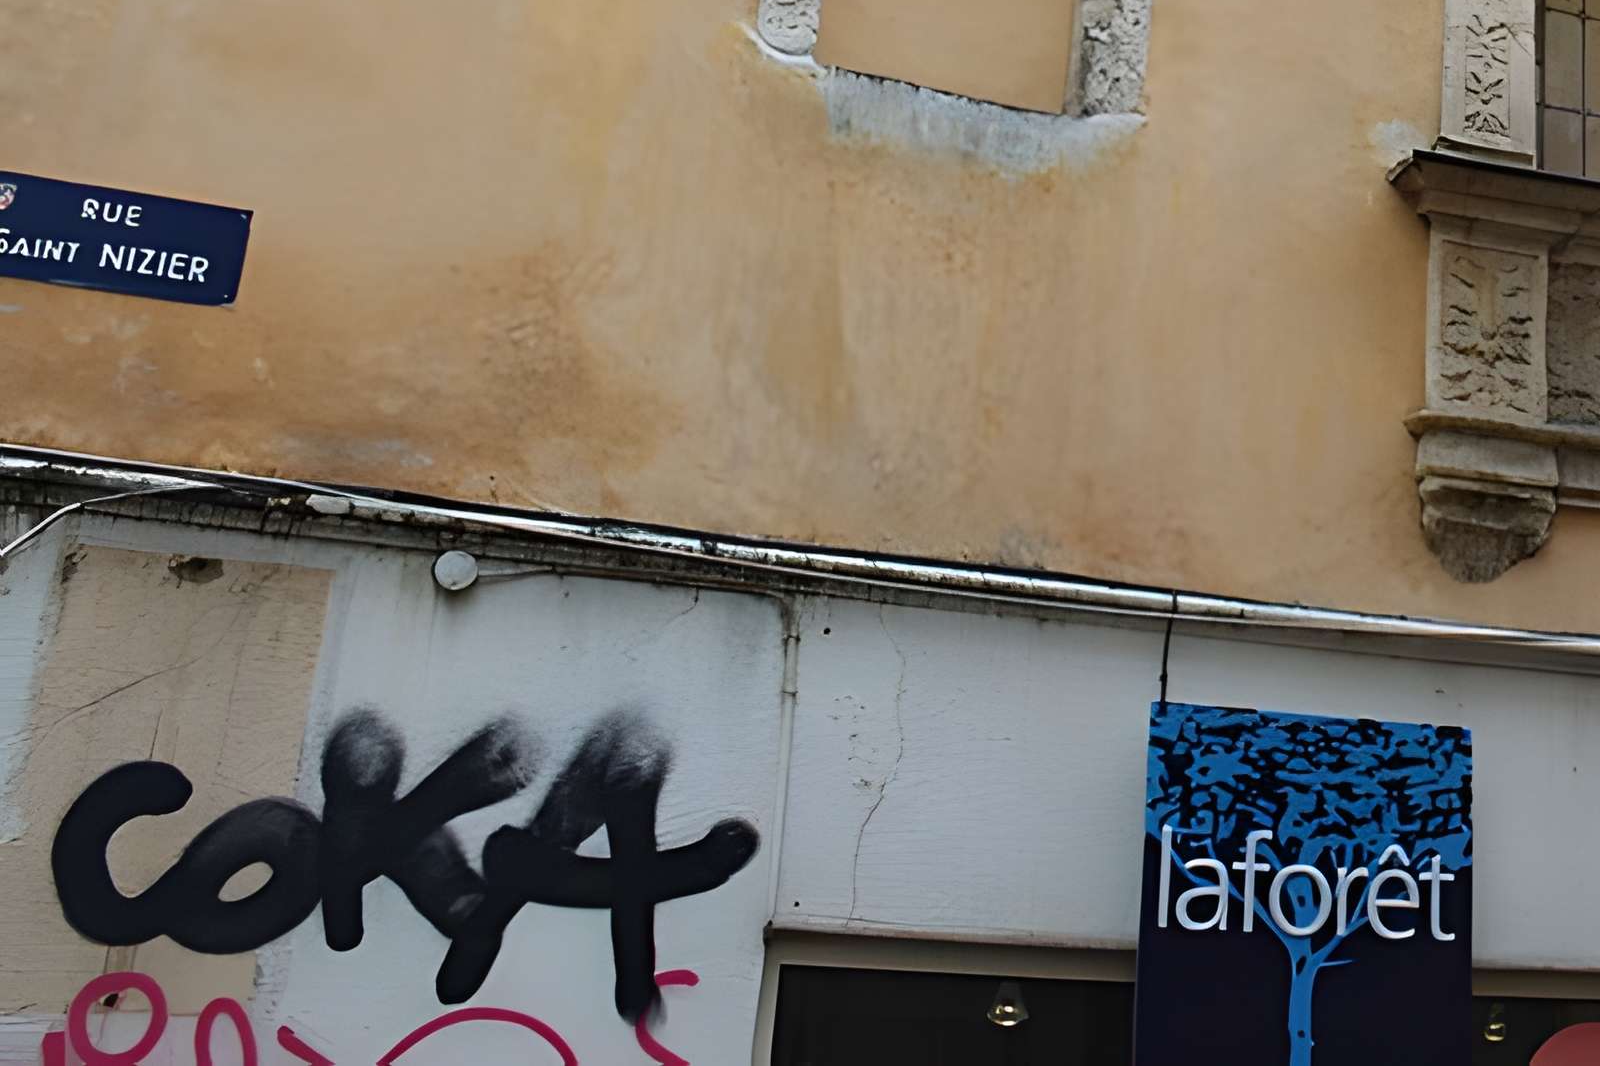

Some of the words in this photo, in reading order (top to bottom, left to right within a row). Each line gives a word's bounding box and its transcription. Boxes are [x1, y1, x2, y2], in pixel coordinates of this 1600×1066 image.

[81, 198, 142, 226] RUE
[99, 243, 209, 282] NIZIER
[1158, 824, 1455, 941] laforêt
